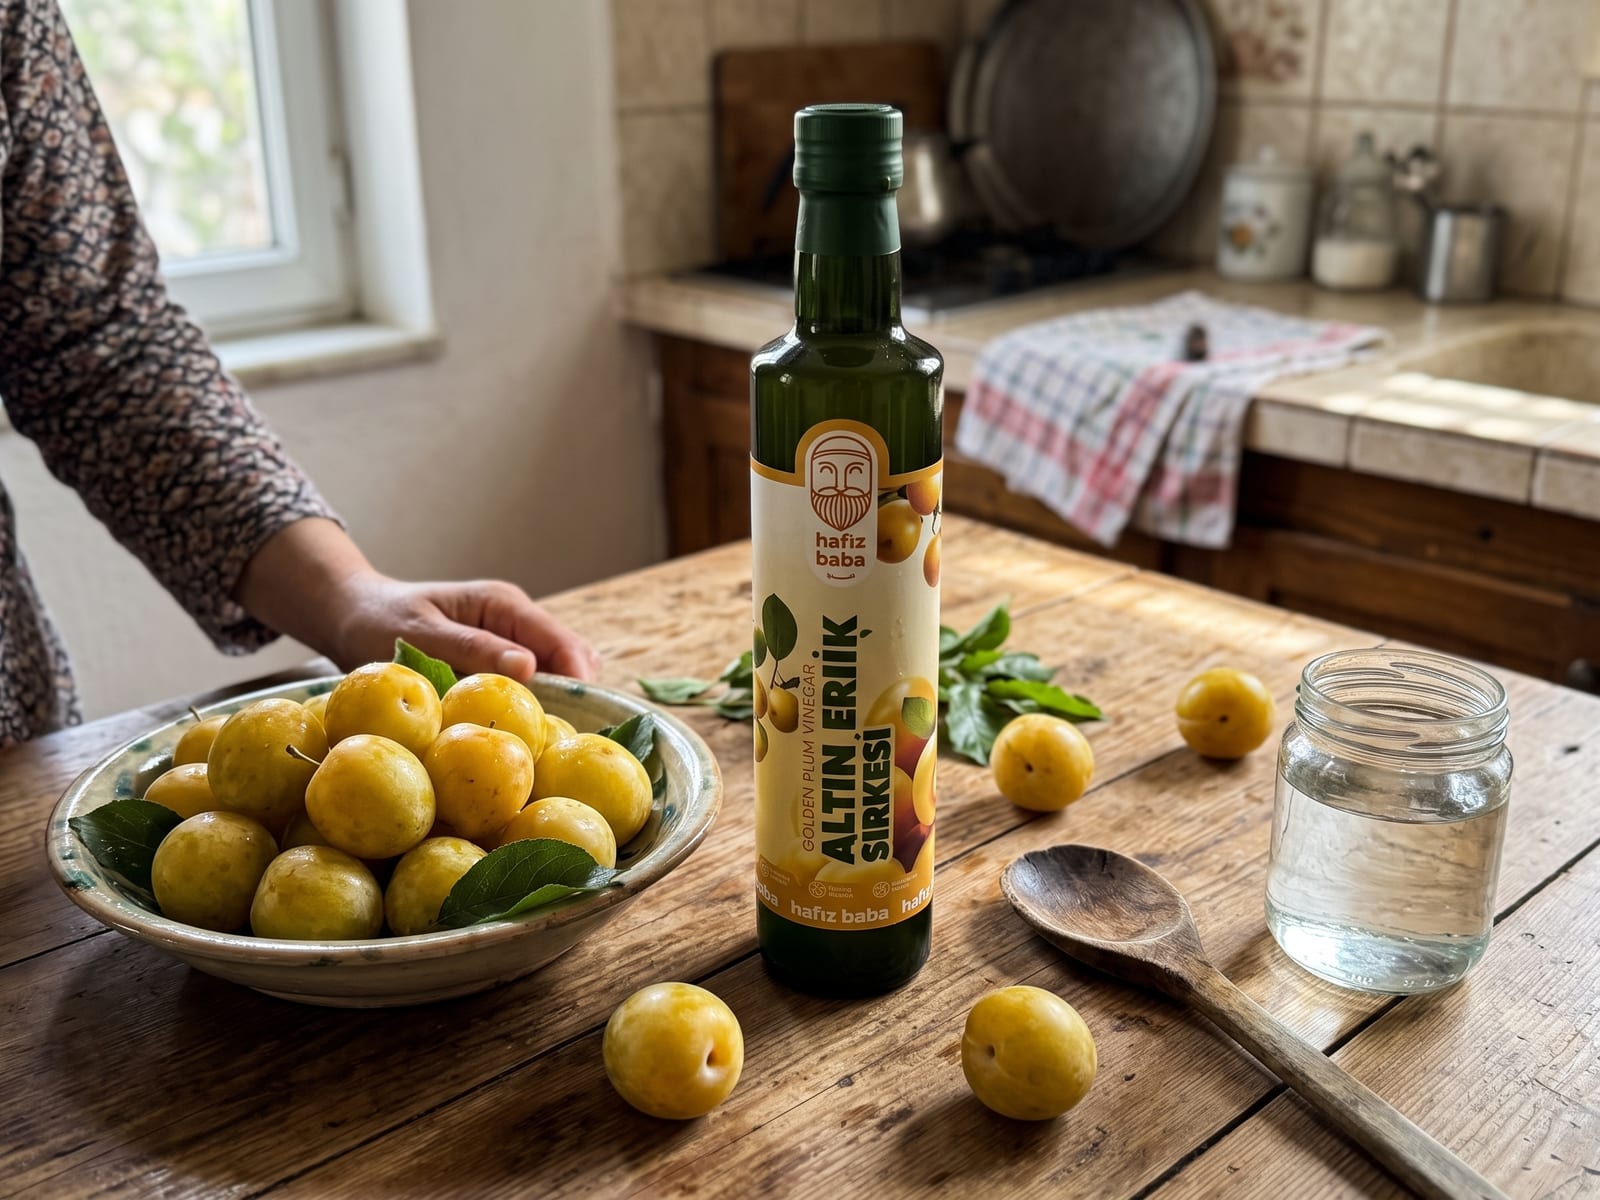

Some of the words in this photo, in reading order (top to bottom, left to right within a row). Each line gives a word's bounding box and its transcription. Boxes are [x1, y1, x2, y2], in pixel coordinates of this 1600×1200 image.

[816, 532, 866, 549] hafiz
[816, 550, 865, 567] baba
[802, 664, 816, 735] VINEGAR
[803, 740, 815, 782] PLUM
[803, 787, 815, 852] GOLDEN
[821, 744, 858, 865] ALTIN
[841, 907, 889, 924] baba
